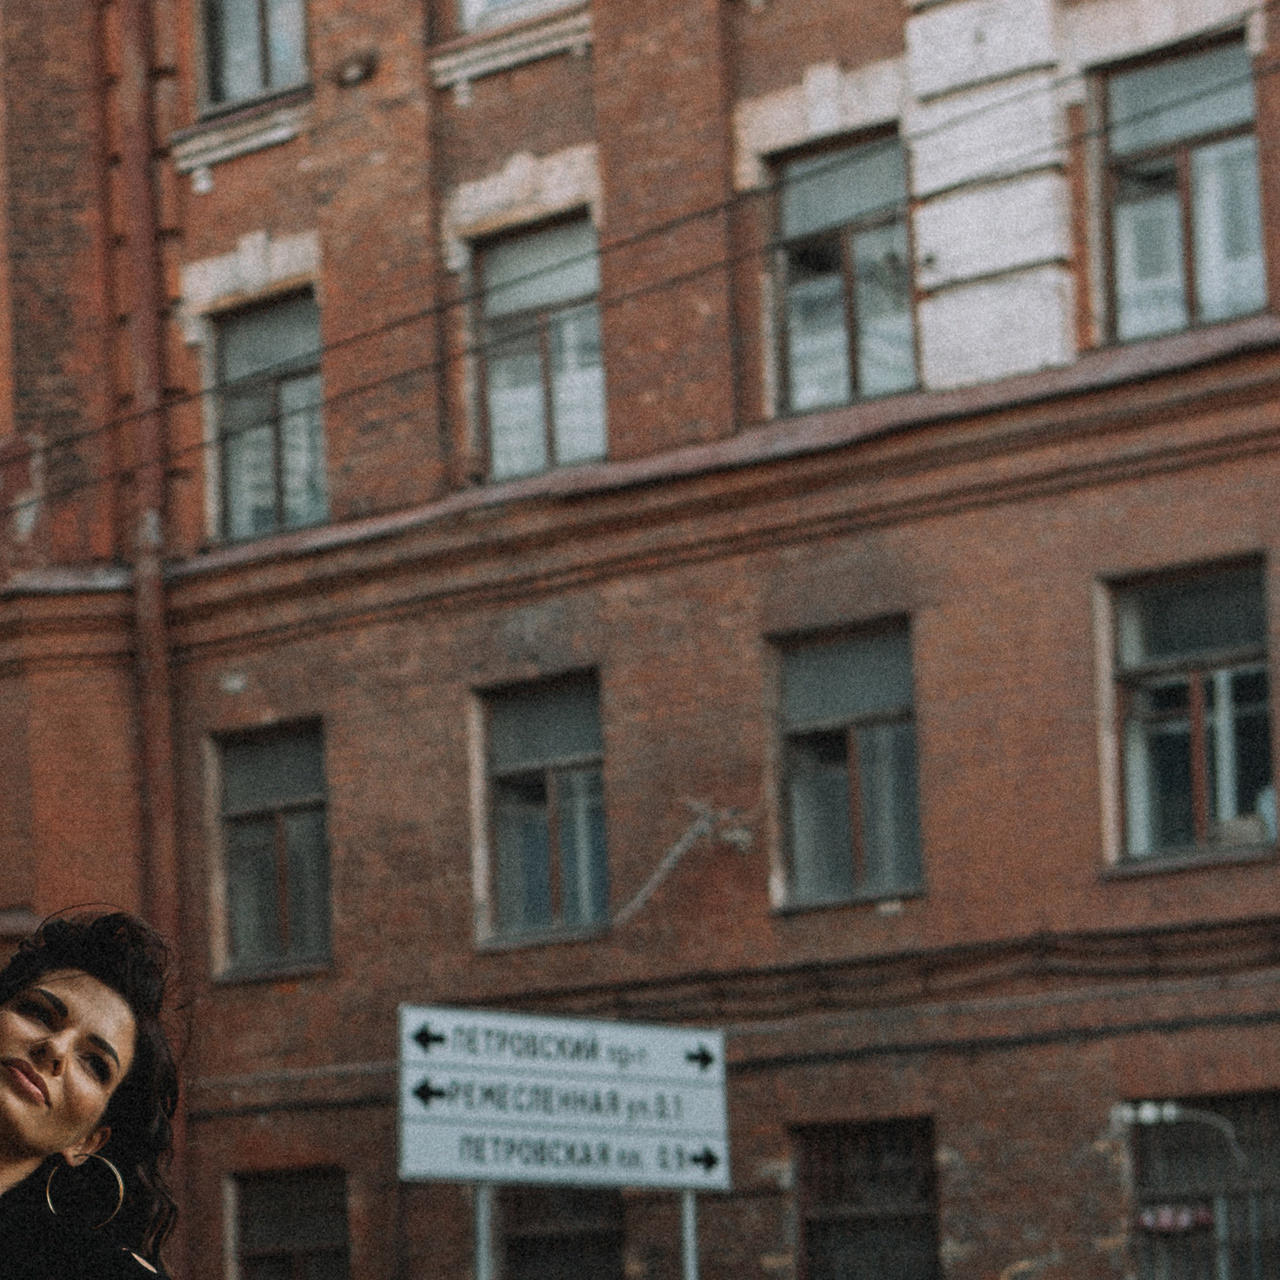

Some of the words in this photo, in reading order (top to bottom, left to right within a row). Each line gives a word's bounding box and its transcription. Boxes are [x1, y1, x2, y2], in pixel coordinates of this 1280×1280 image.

[451, 1024, 600, 1062] ПЕТРОВСКИЙ
[446, 1080, 620, 1115] РЕМЕСЛЕННАЯ
[458, 1133, 612, 1168] ПЕТРОВСКАЯ
